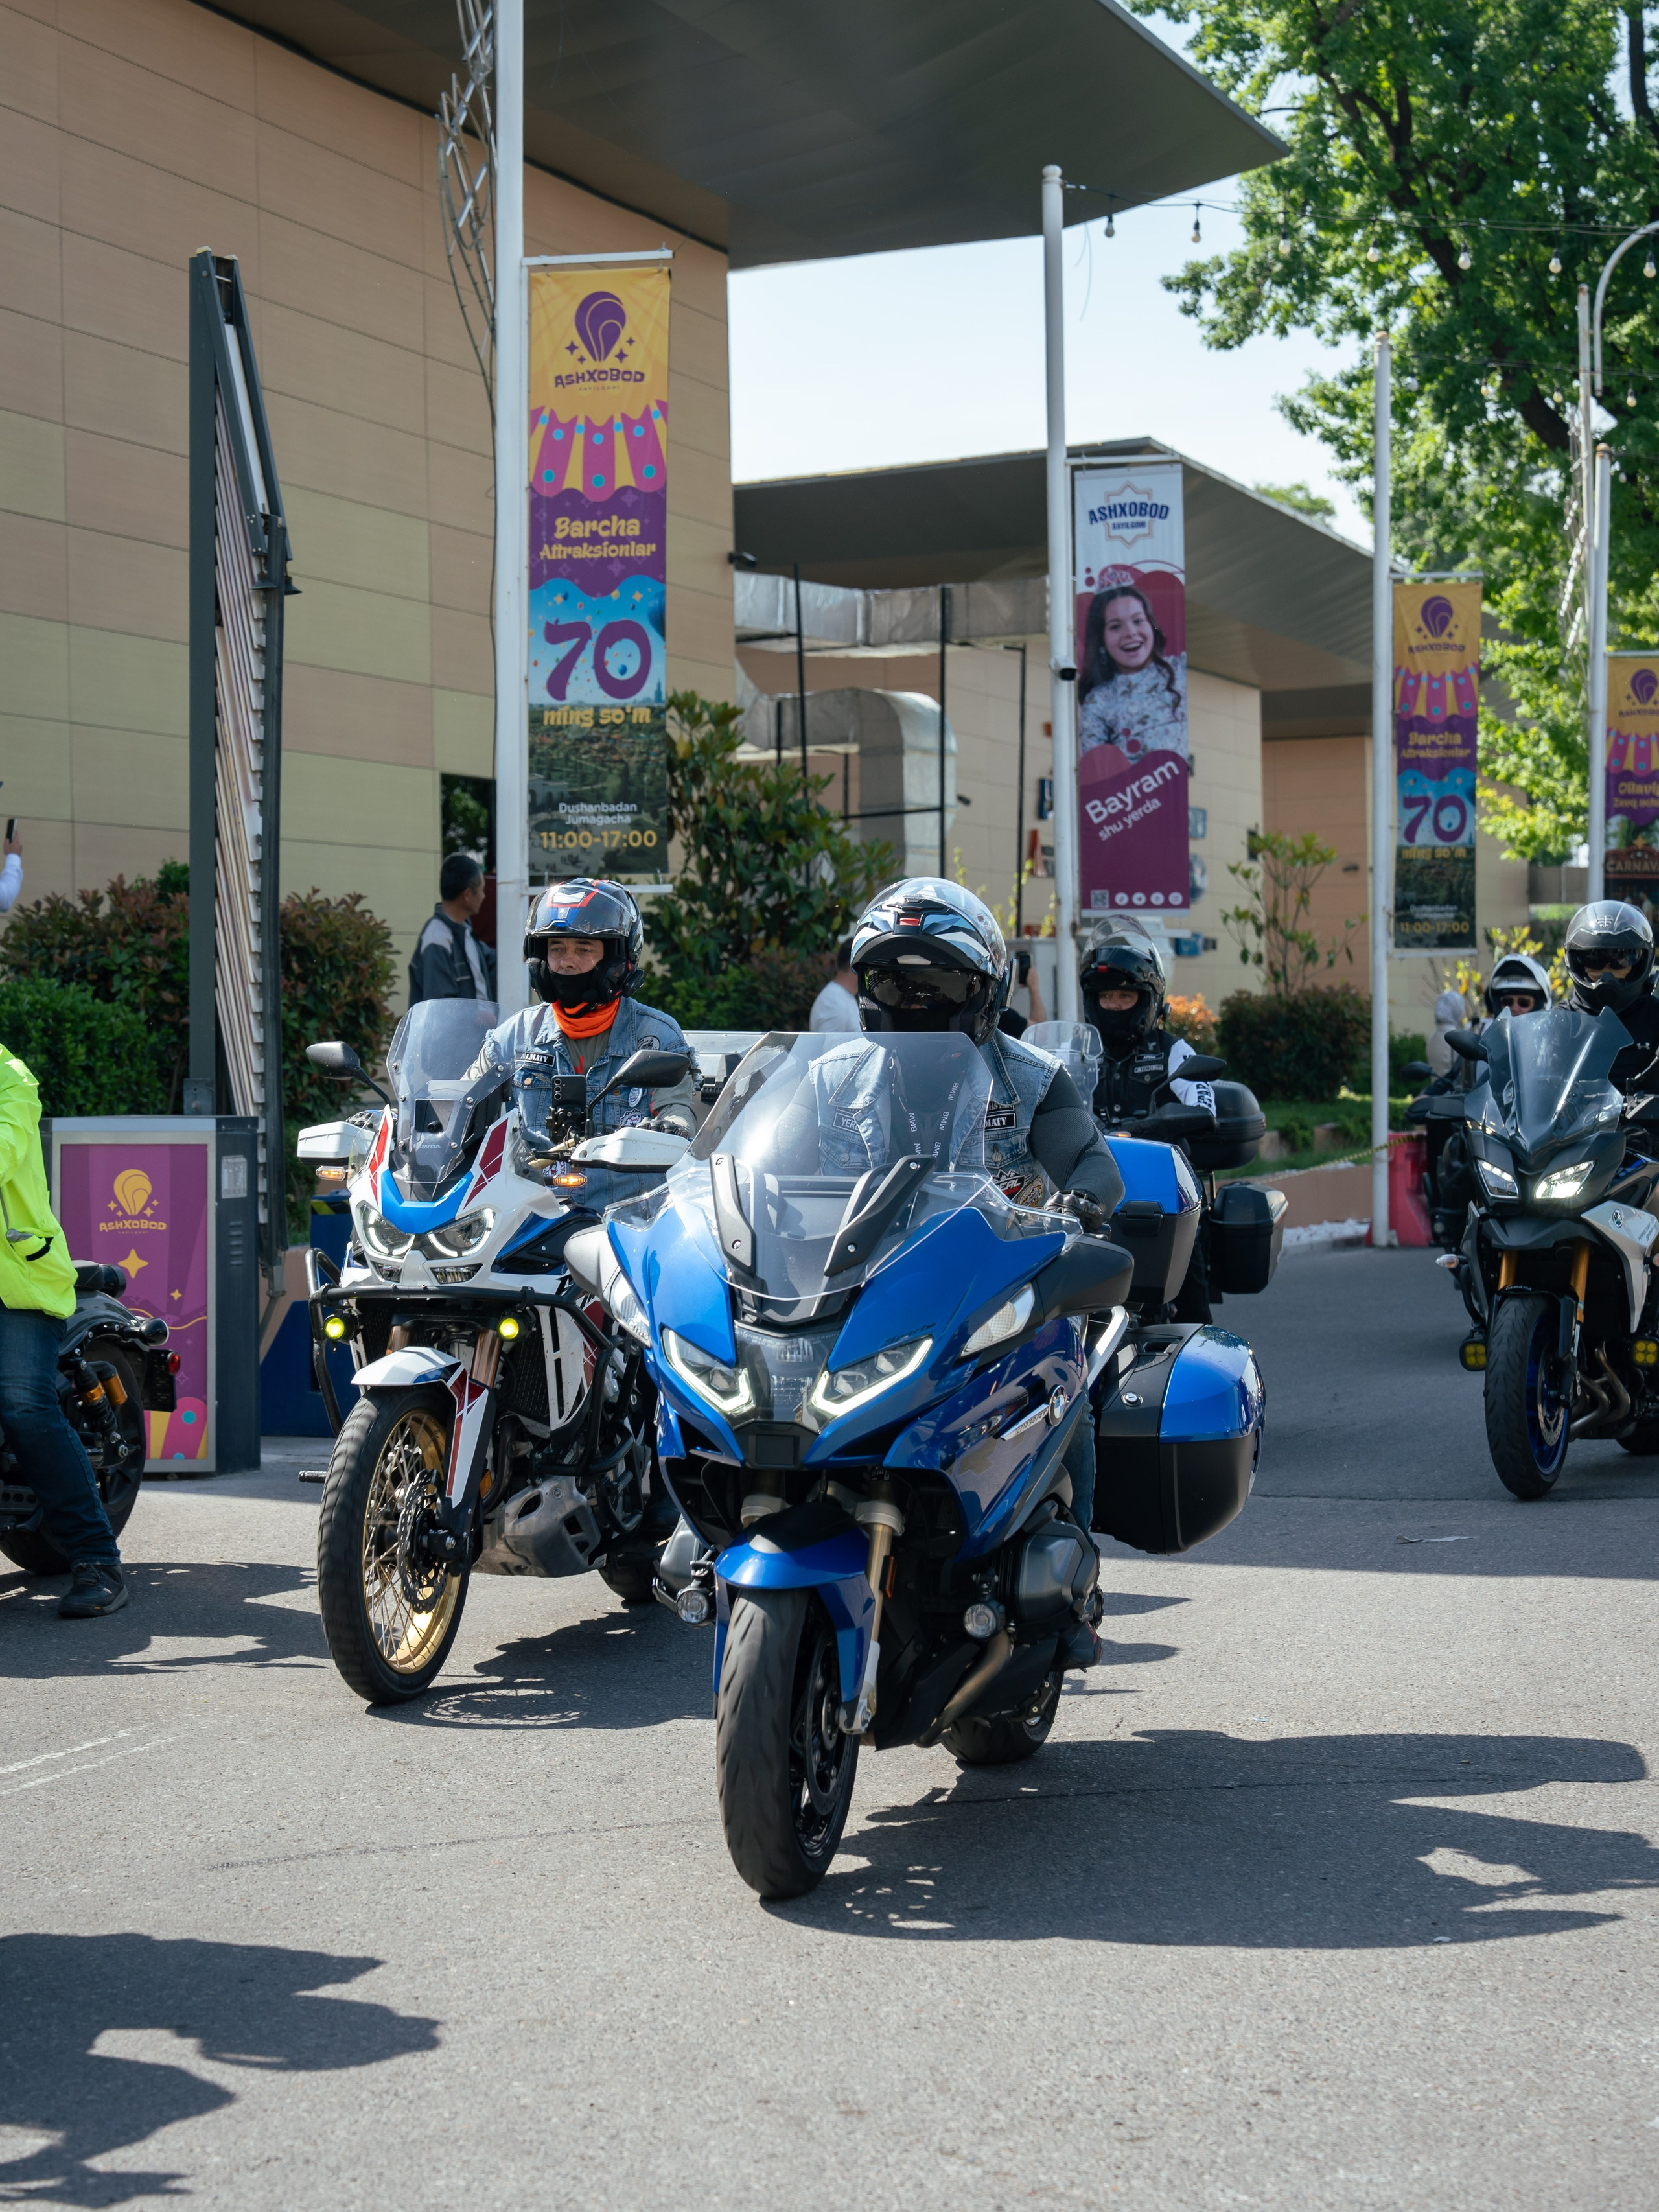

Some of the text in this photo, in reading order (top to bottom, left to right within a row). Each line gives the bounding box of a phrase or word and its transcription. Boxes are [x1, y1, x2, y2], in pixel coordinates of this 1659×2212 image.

[555, 367, 645, 388] ASHXOBOD
[1088, 502, 1170, 526] ASHXOBOD
[554, 515, 641, 539] Barcha
[539, 541, 656, 561] Attraksionlar
[545, 620, 651, 702] 70
[543, 705, 651, 728] ming so'm
[1085, 760, 1179, 824] Bayram
[559, 801, 638, 813] Dushanbadan
[565, 813, 632, 826] Jumagacha
[1098, 798, 1162, 841] shu yerda
[1403, 795, 1467, 843] 70
[540, 830, 658, 849] 11:00-17:00
[1606, 860, 1659, 872] CARNAV
[1400, 920, 1470, 933] 11:00-17:00
[520, 1053, 548, 1062] ALMATY
[948, 1082, 959, 1101] BMW
[909, 1113, 918, 1132] BMW
[939, 1111, 949, 1131] BMW
[99, 1219, 167, 1232] ASHXOBOD
